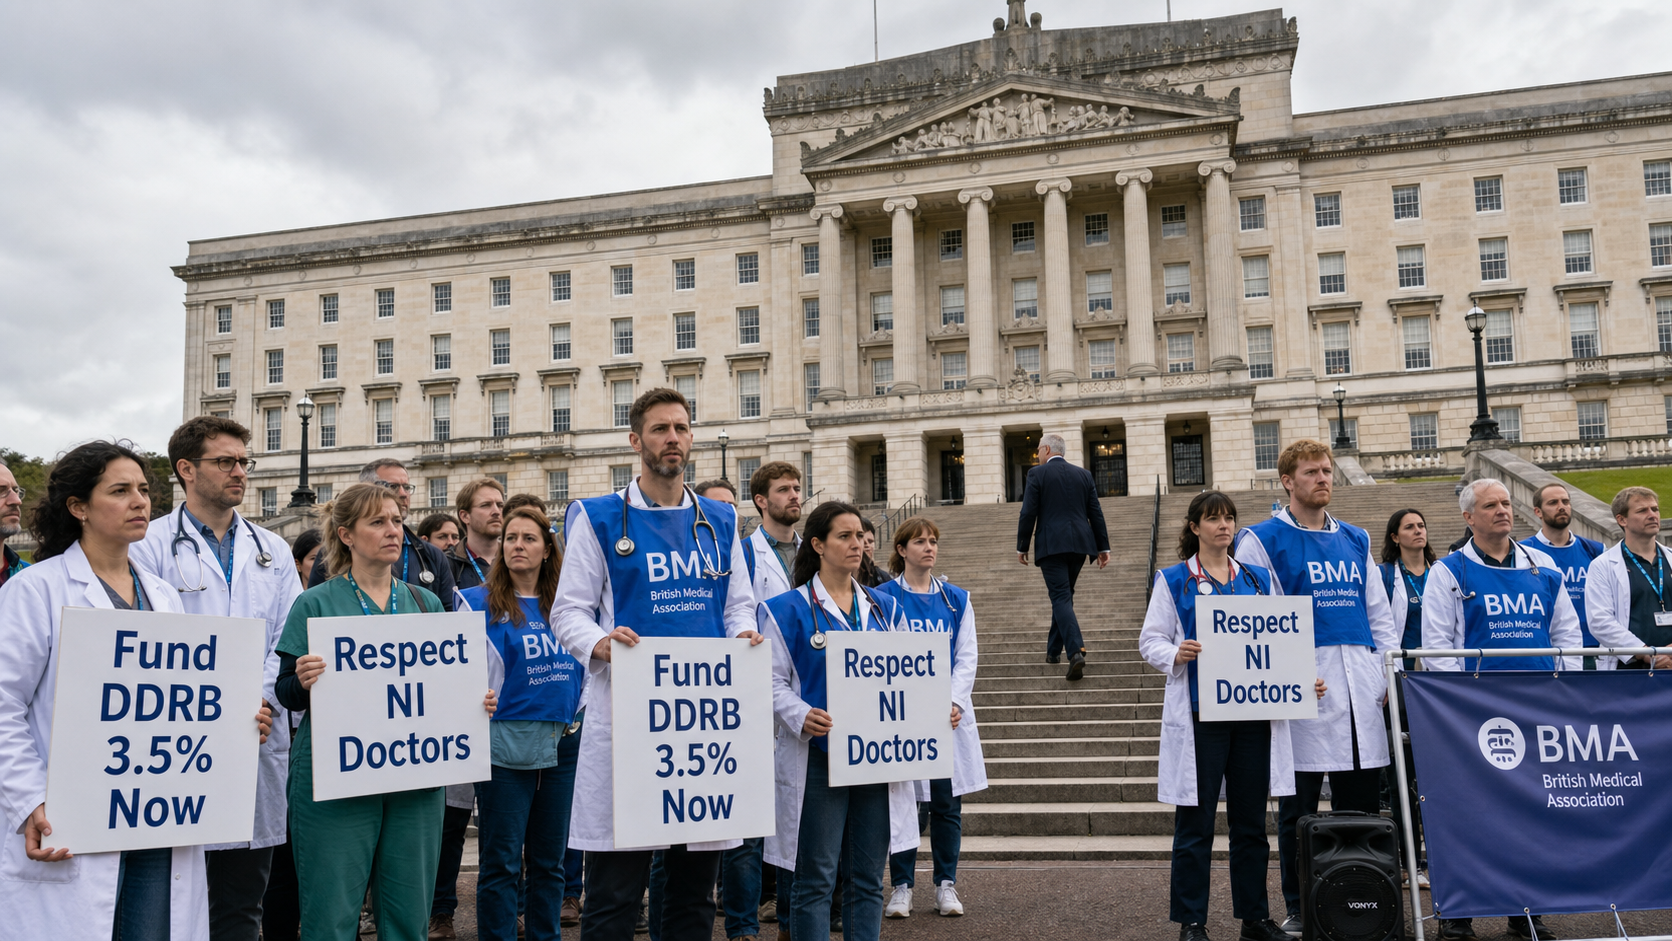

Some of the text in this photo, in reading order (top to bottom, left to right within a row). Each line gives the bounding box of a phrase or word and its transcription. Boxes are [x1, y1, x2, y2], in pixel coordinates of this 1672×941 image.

[1307, 560, 1363, 585] BMA
[650, 587, 713, 601] British Medical
[652, 601, 706, 614] Association
[1483, 593, 1546, 616] BMA
[1212, 609, 1300, 640] Respect
[113, 630, 218, 672] Fund
[334, 634, 469, 677] Respect
[522, 633, 571, 660] BM
[1245, 645, 1271, 670] NI
[654, 654, 733, 687] Fund
[844, 648, 936, 686] Respect
[101, 683, 222, 722] DDRB
[386, 683, 425, 720] NI
[878, 691, 905, 722] NI
[1216, 679, 1303, 705] Doctors
[648, 698, 741, 733] DDRB
[104, 734, 213, 775] 3.5%
[339, 733, 471, 773] Doctors
[847, 734, 938, 766] Doctors
[1536, 724, 1639, 763] BMA
[655, 742, 738, 779] 3.5%
[1543, 772, 1643, 788] British Medical
[109, 788, 207, 830] Now
[662, 788, 734, 825] Now
[1547, 792, 1625, 808] Association
[1347, 901, 1378, 909] VONYX
